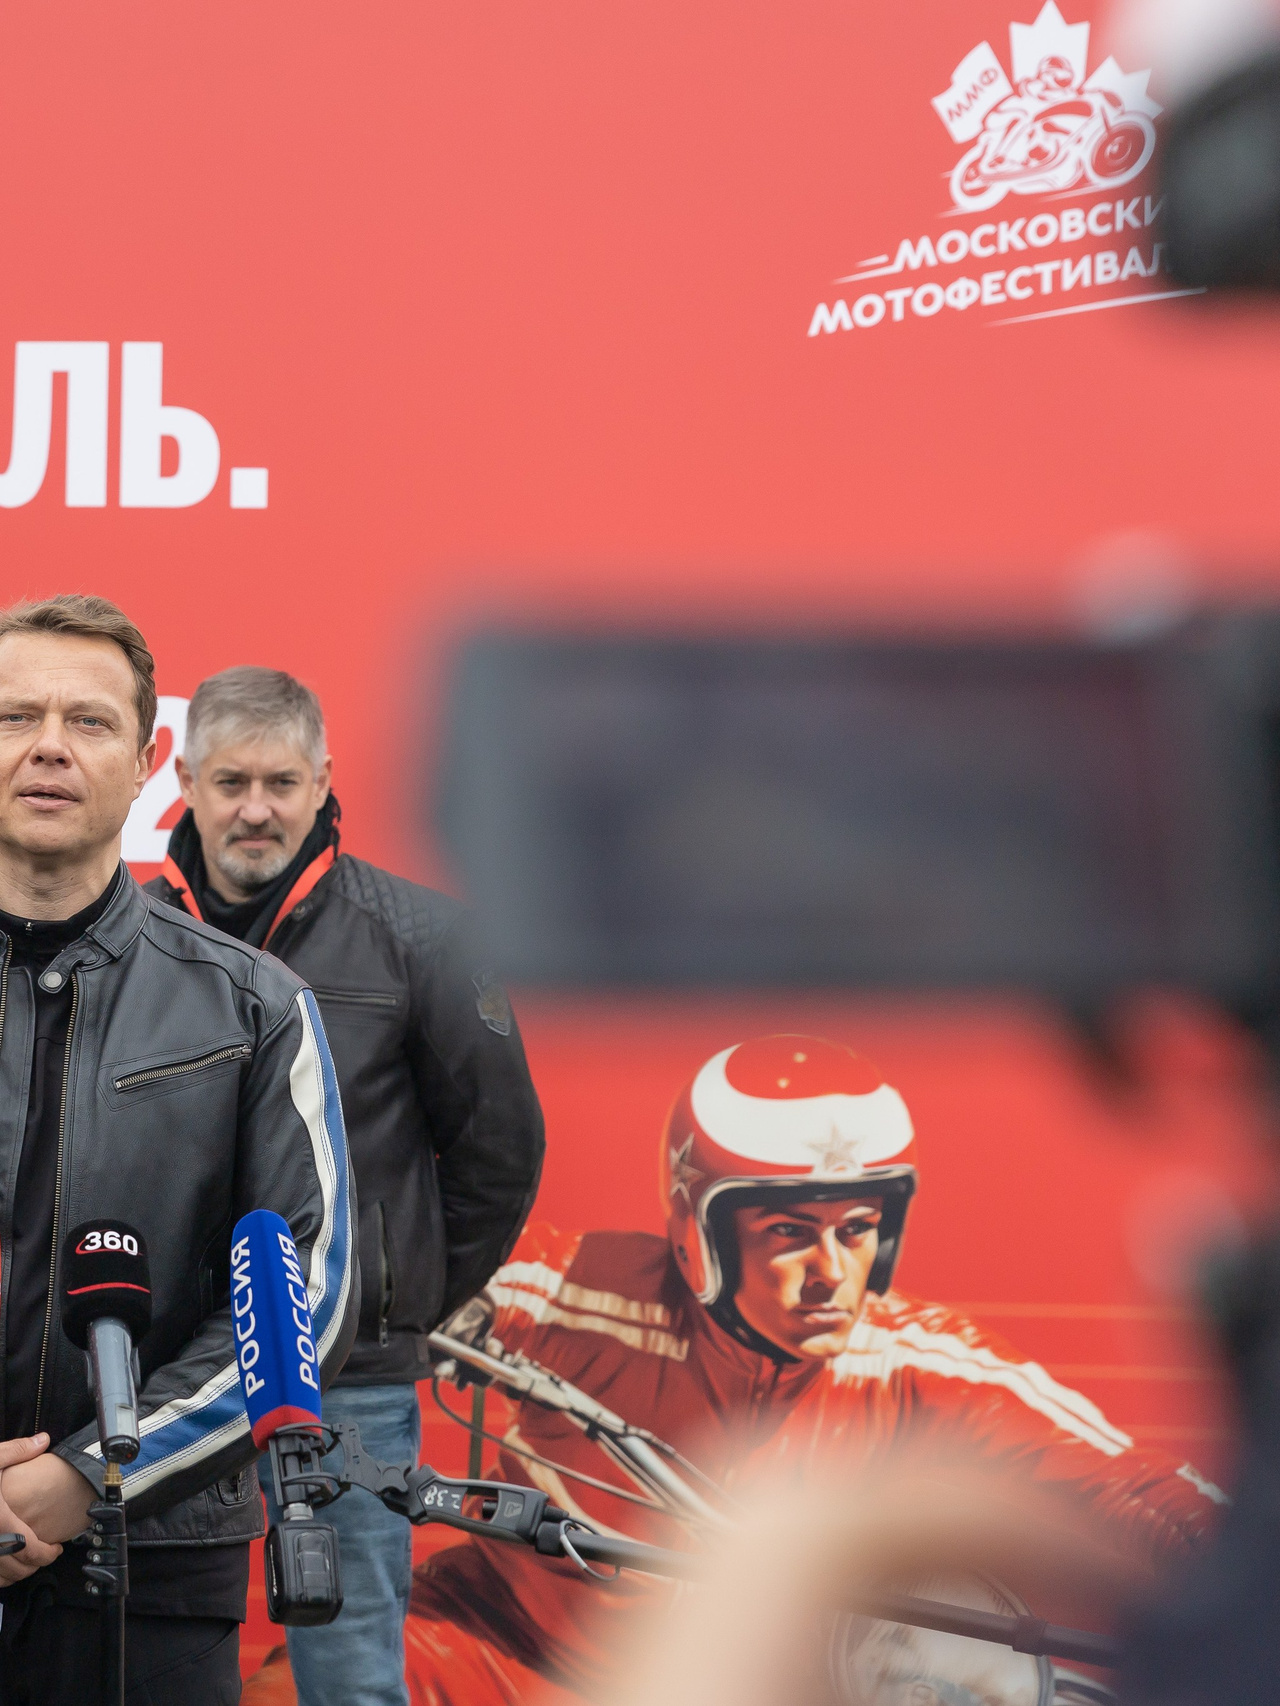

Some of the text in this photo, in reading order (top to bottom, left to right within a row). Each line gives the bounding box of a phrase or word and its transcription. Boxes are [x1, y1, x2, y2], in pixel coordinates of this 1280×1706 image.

[892, 194, 1166, 273] МОСКОВСКИ
[84, 1230, 139, 1256] 360
[231, 1236, 266, 1399] РОССИЯ
[277, 1232, 319, 1391] РОССИЯ
